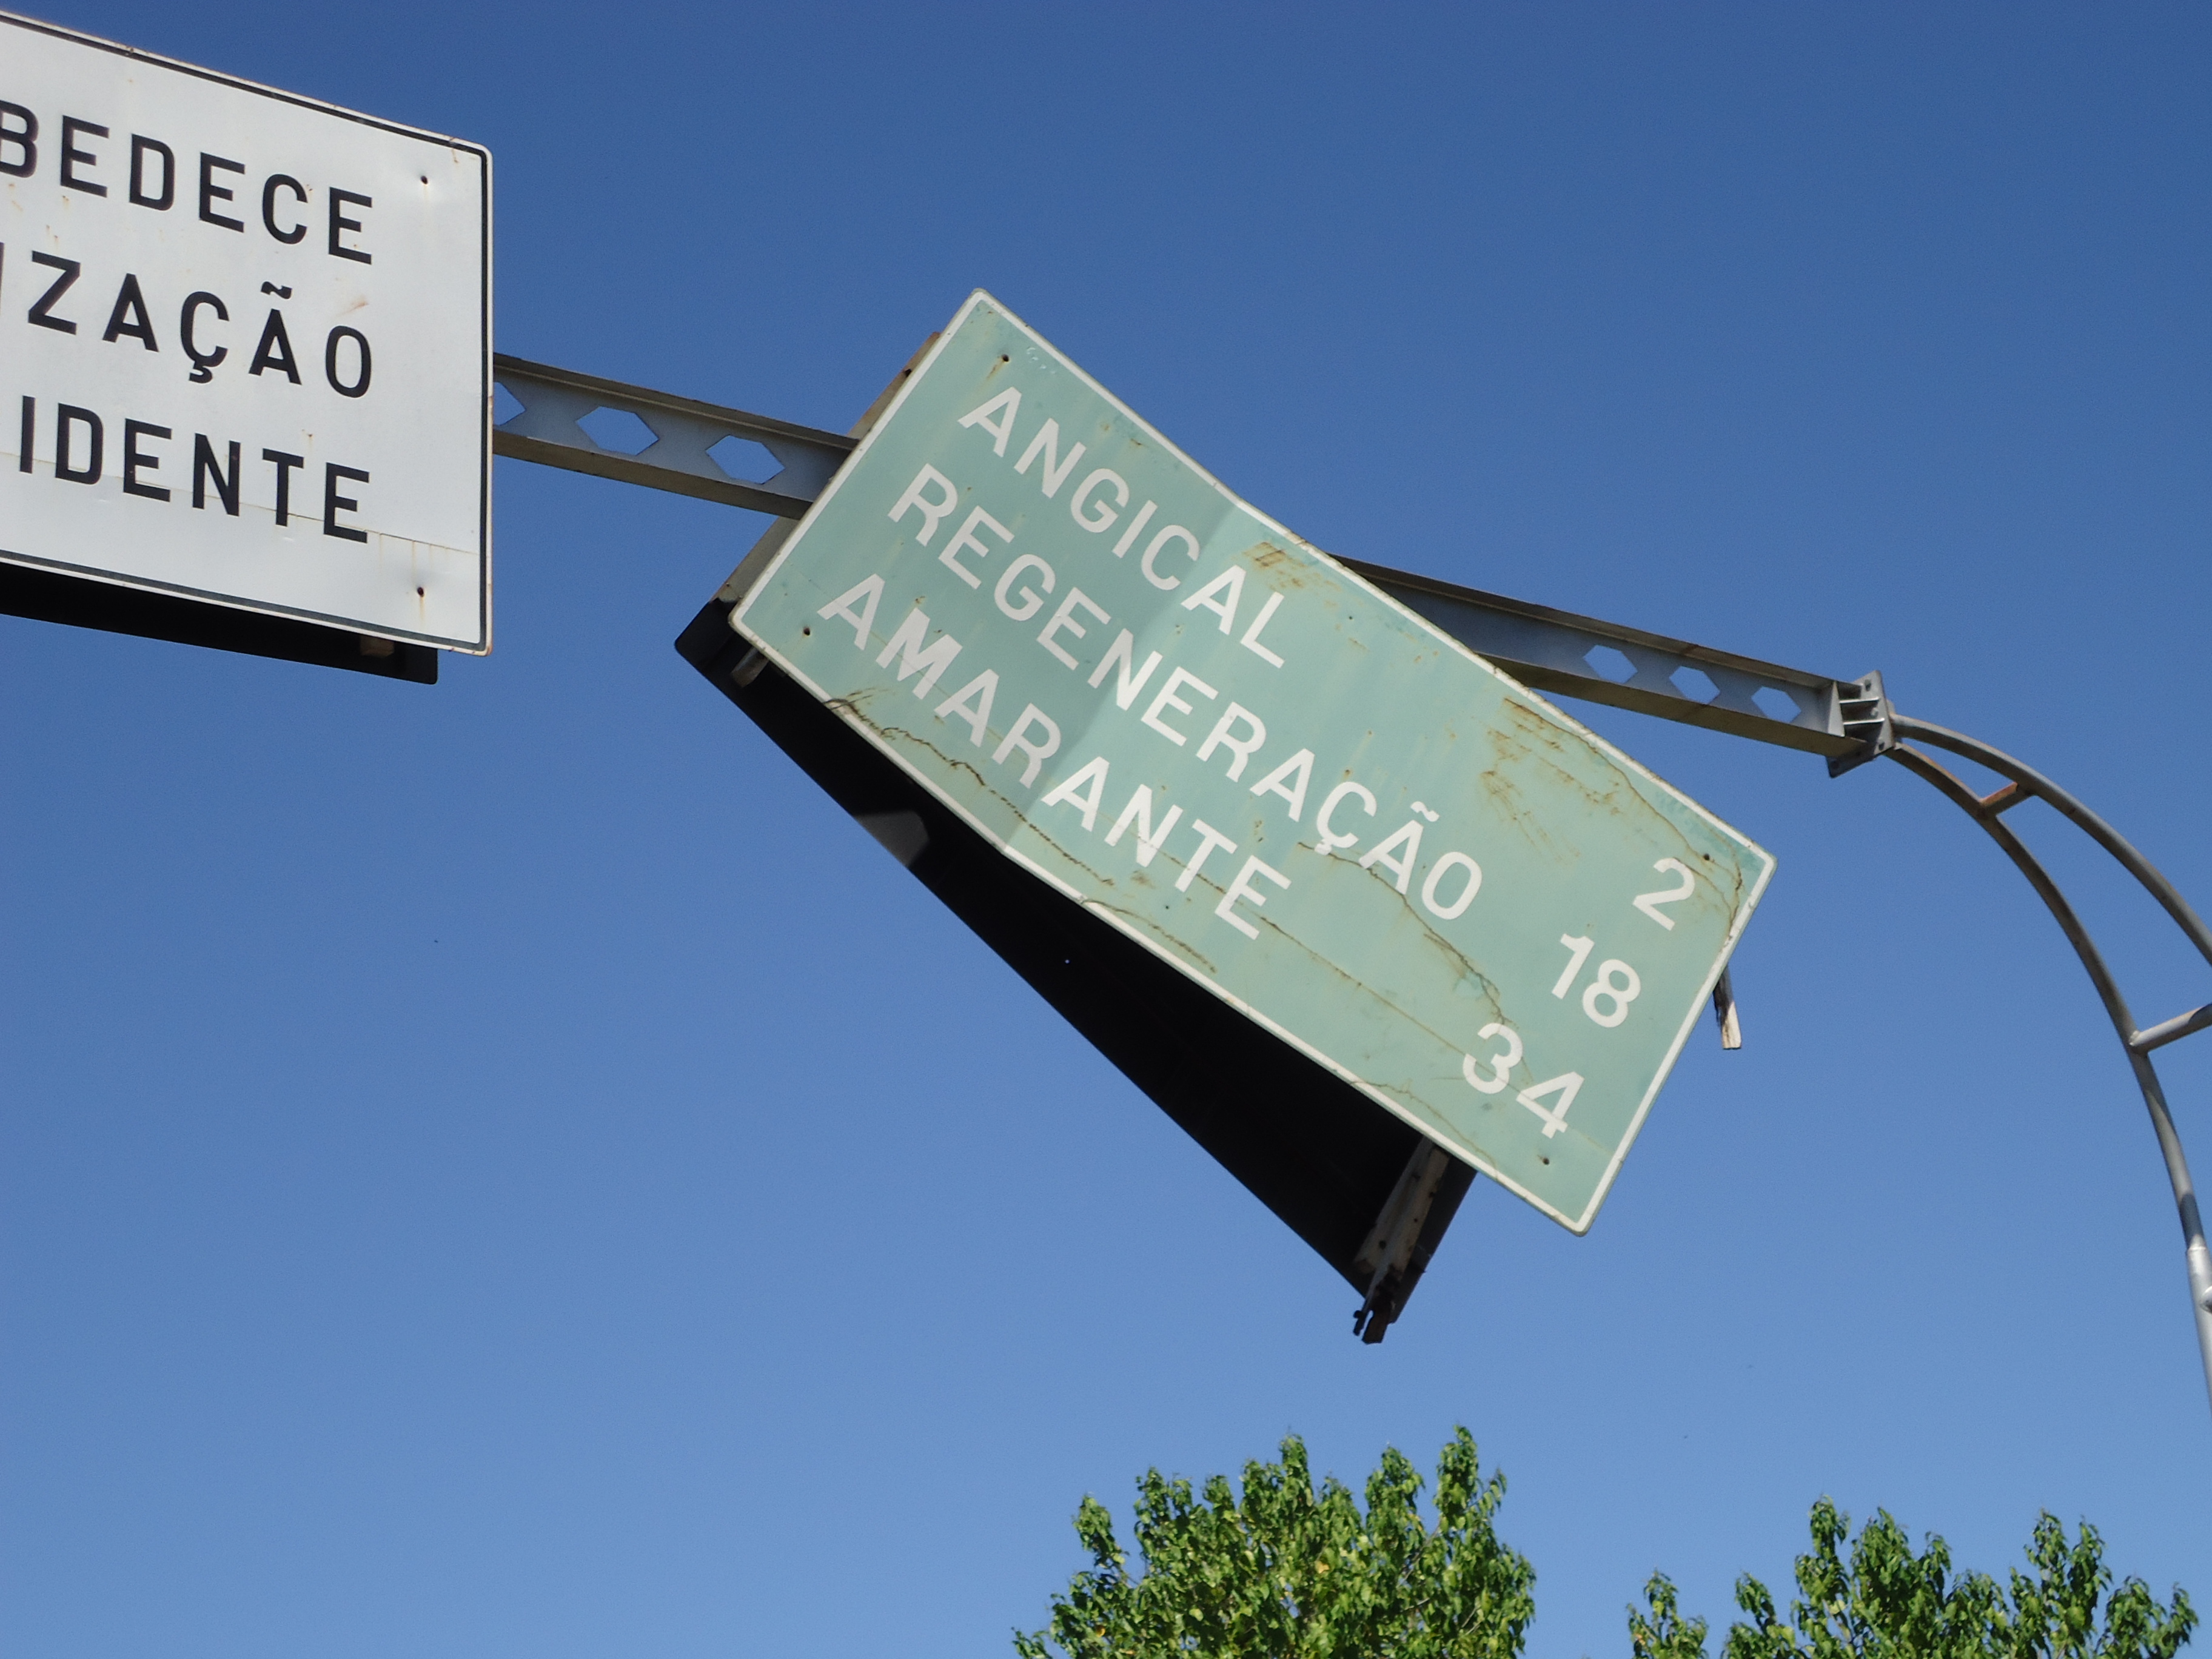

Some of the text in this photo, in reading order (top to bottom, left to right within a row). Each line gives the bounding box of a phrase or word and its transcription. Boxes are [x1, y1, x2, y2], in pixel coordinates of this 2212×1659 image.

[0, 99, 373, 265] BEDECE
[0, 242, 372, 398] ZAÇÃO
[19, 396, 370, 543] IDENTE
[887, 463, 1641, 1028] REGENERAÇÃO 18
[957, 386, 1695, 931] ANGICAL 2
[817, 573, 1585, 1139] AMARANTE 34
